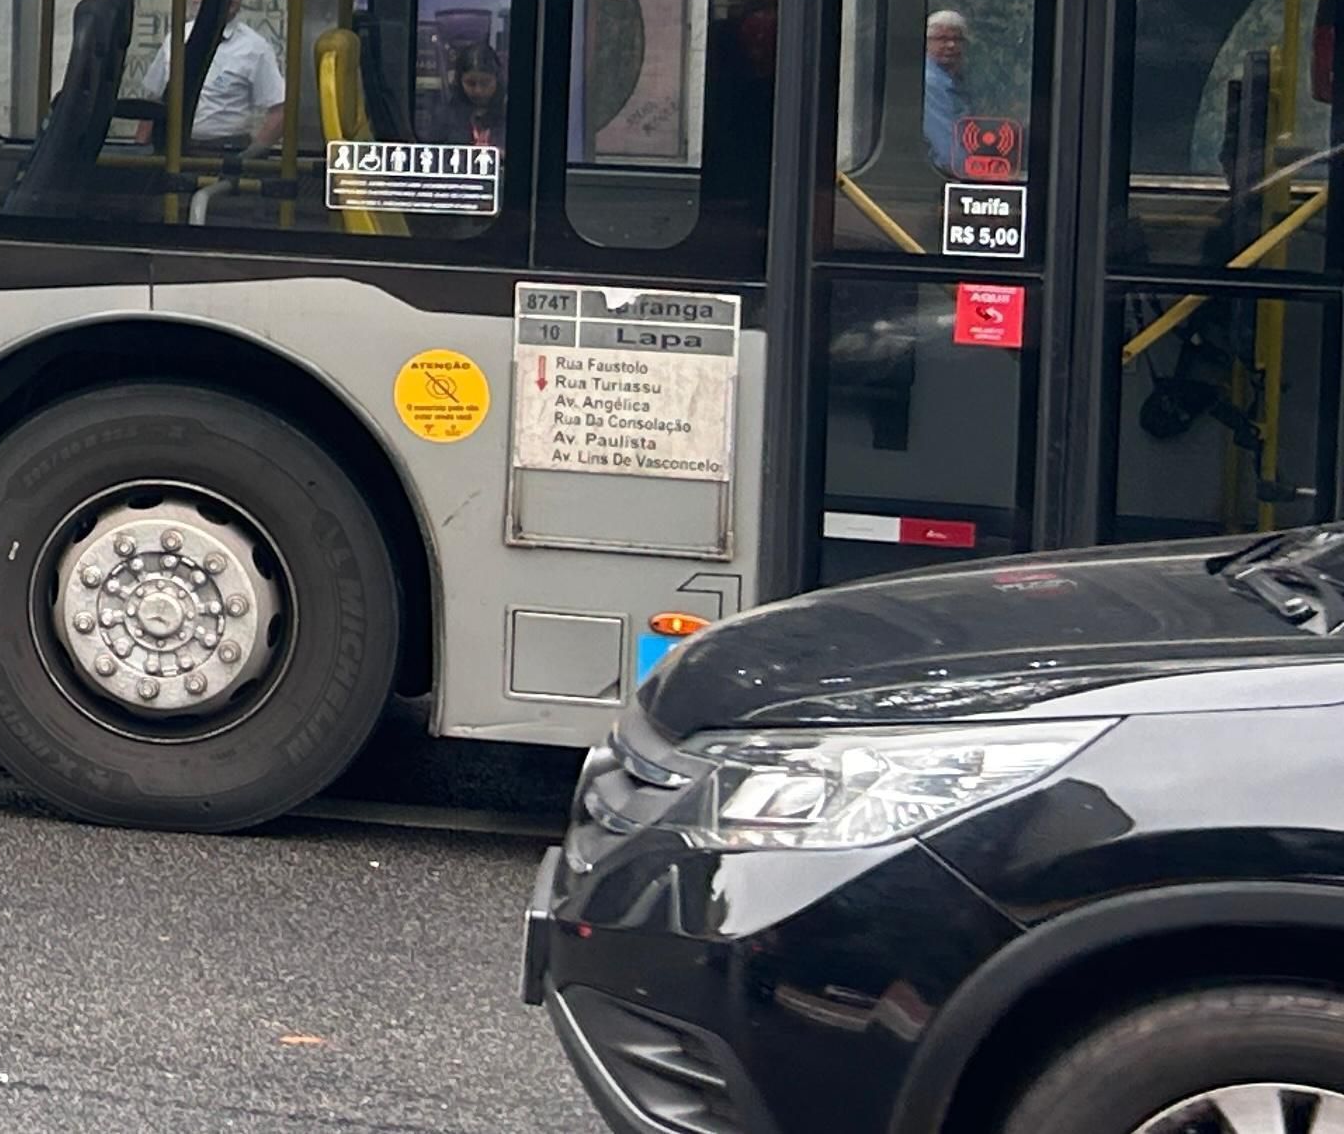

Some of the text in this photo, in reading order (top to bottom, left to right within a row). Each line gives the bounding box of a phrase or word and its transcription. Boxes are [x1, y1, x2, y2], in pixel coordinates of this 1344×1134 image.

[960, 197, 1009, 216] Tarifa
[950, 226, 1019, 248] R$ 5,00
[526, 293, 570, 310] 874T
[540, 324, 703, 349] 10 Lapa
[555, 357, 648, 376] Rua Faustolo
[555, 376, 585, 390] Rua
[582, 396, 650, 416] Angélica
[554, 413, 692, 435] Rua Da Consolação
[585, 432, 657, 451] Paulista
[577, 449, 608, 464] Lins
[612, 452, 632, 466] De
